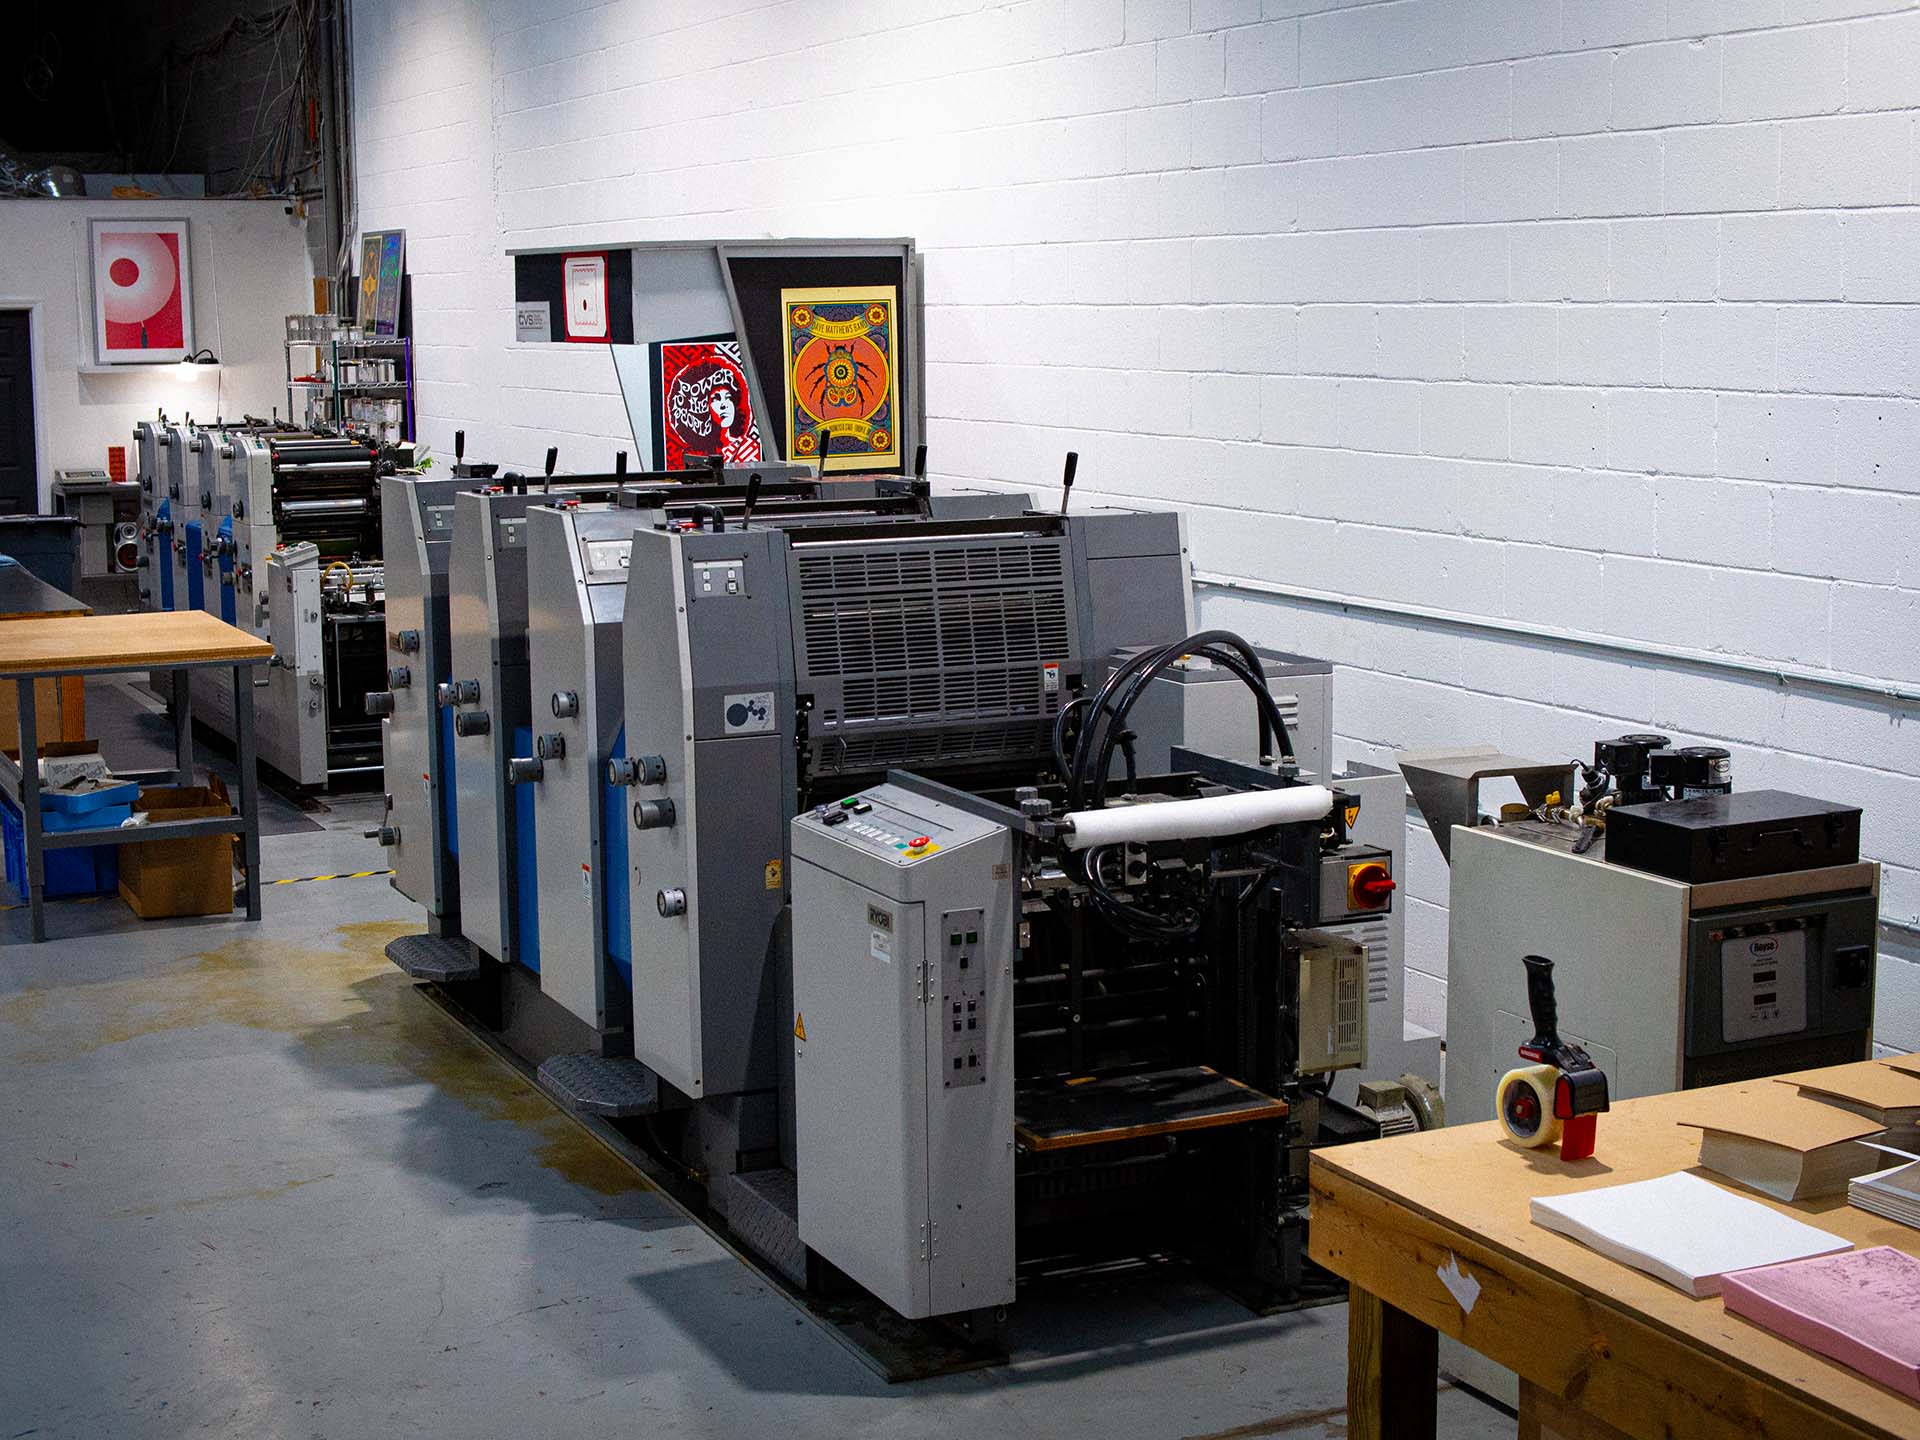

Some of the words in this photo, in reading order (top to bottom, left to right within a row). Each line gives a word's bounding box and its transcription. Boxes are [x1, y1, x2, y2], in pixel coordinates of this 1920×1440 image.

[826, 323, 853, 335] MATTHEWS
[852, 319, 869, 331] BAND
[678, 368, 738, 397] POWER
[673, 407, 712, 437] PEOPLE
[869, 906, 890, 930] RYOBI
